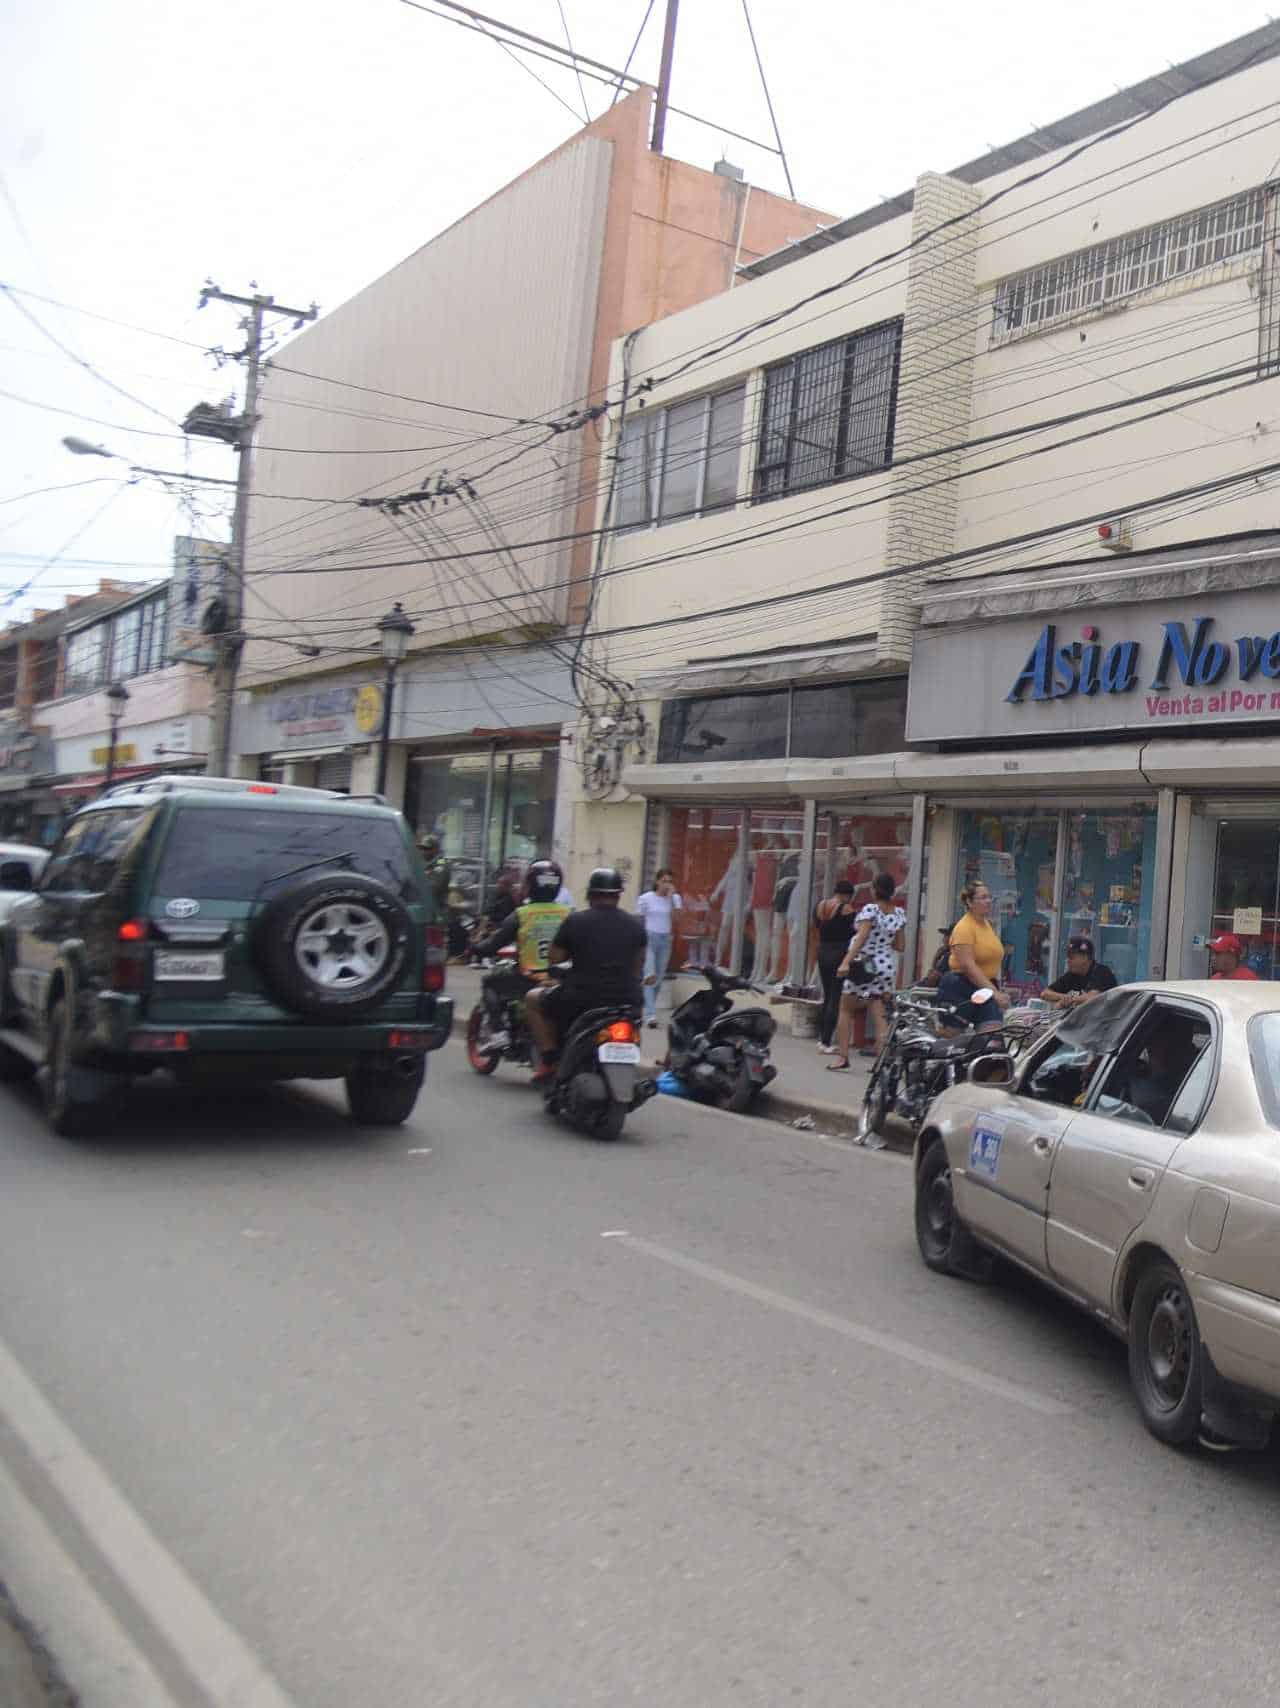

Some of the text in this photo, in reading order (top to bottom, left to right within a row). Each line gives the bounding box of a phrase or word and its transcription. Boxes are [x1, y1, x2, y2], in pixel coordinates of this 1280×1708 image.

[1006, 624, 1140, 703] Asia
[1146, 694, 1204, 716] Venta
[1208, 692, 1226, 712] al
[1229, 690, 1267, 712] Por
